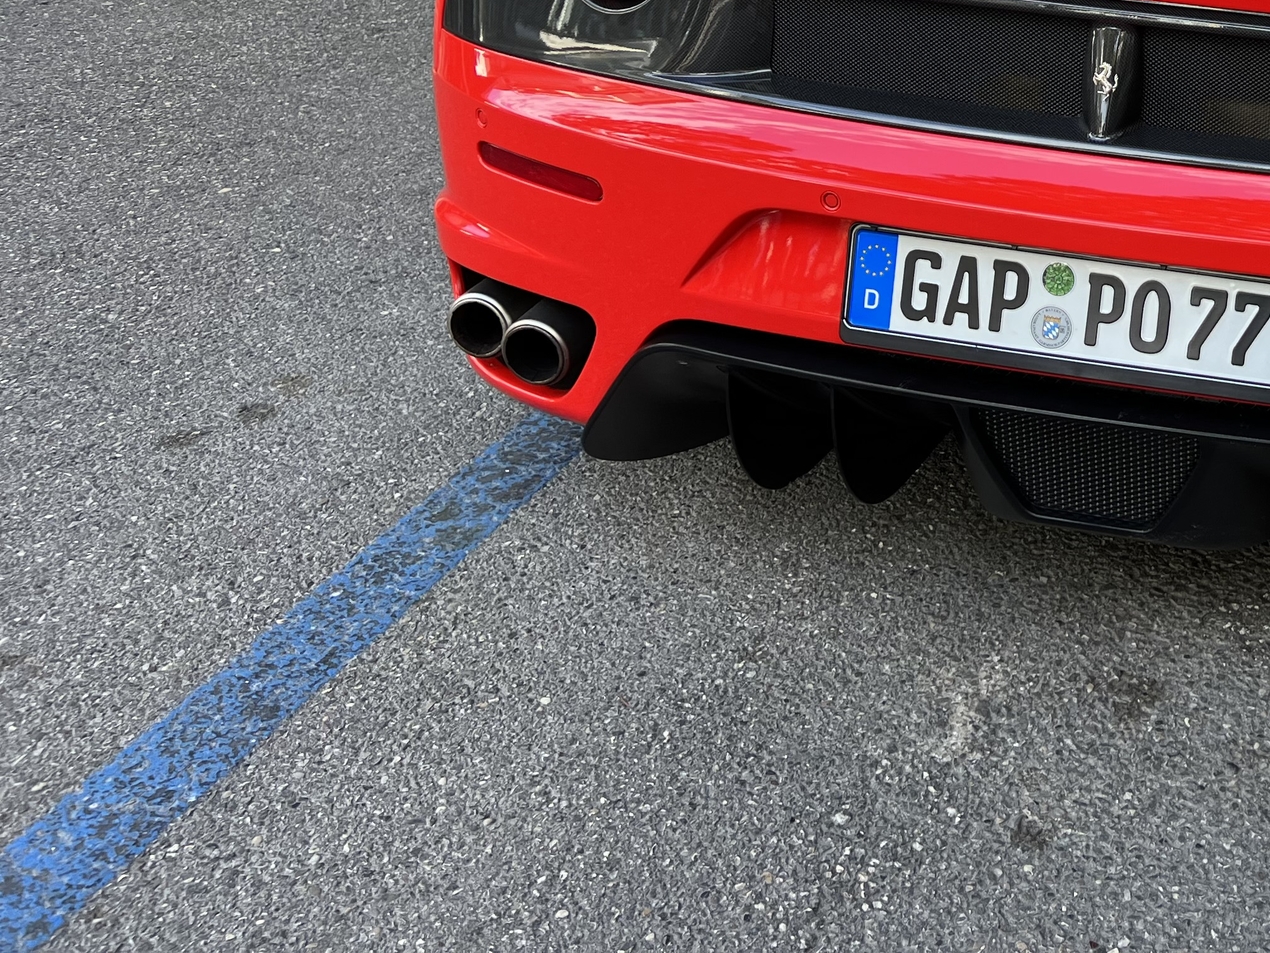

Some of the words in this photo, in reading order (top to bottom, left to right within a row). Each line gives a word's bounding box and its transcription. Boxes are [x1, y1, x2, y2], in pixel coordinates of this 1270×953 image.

[863, 288, 880, 310] D
[900, 249, 1030, 333] GAP
[1083, 271, 1172, 355] PO
